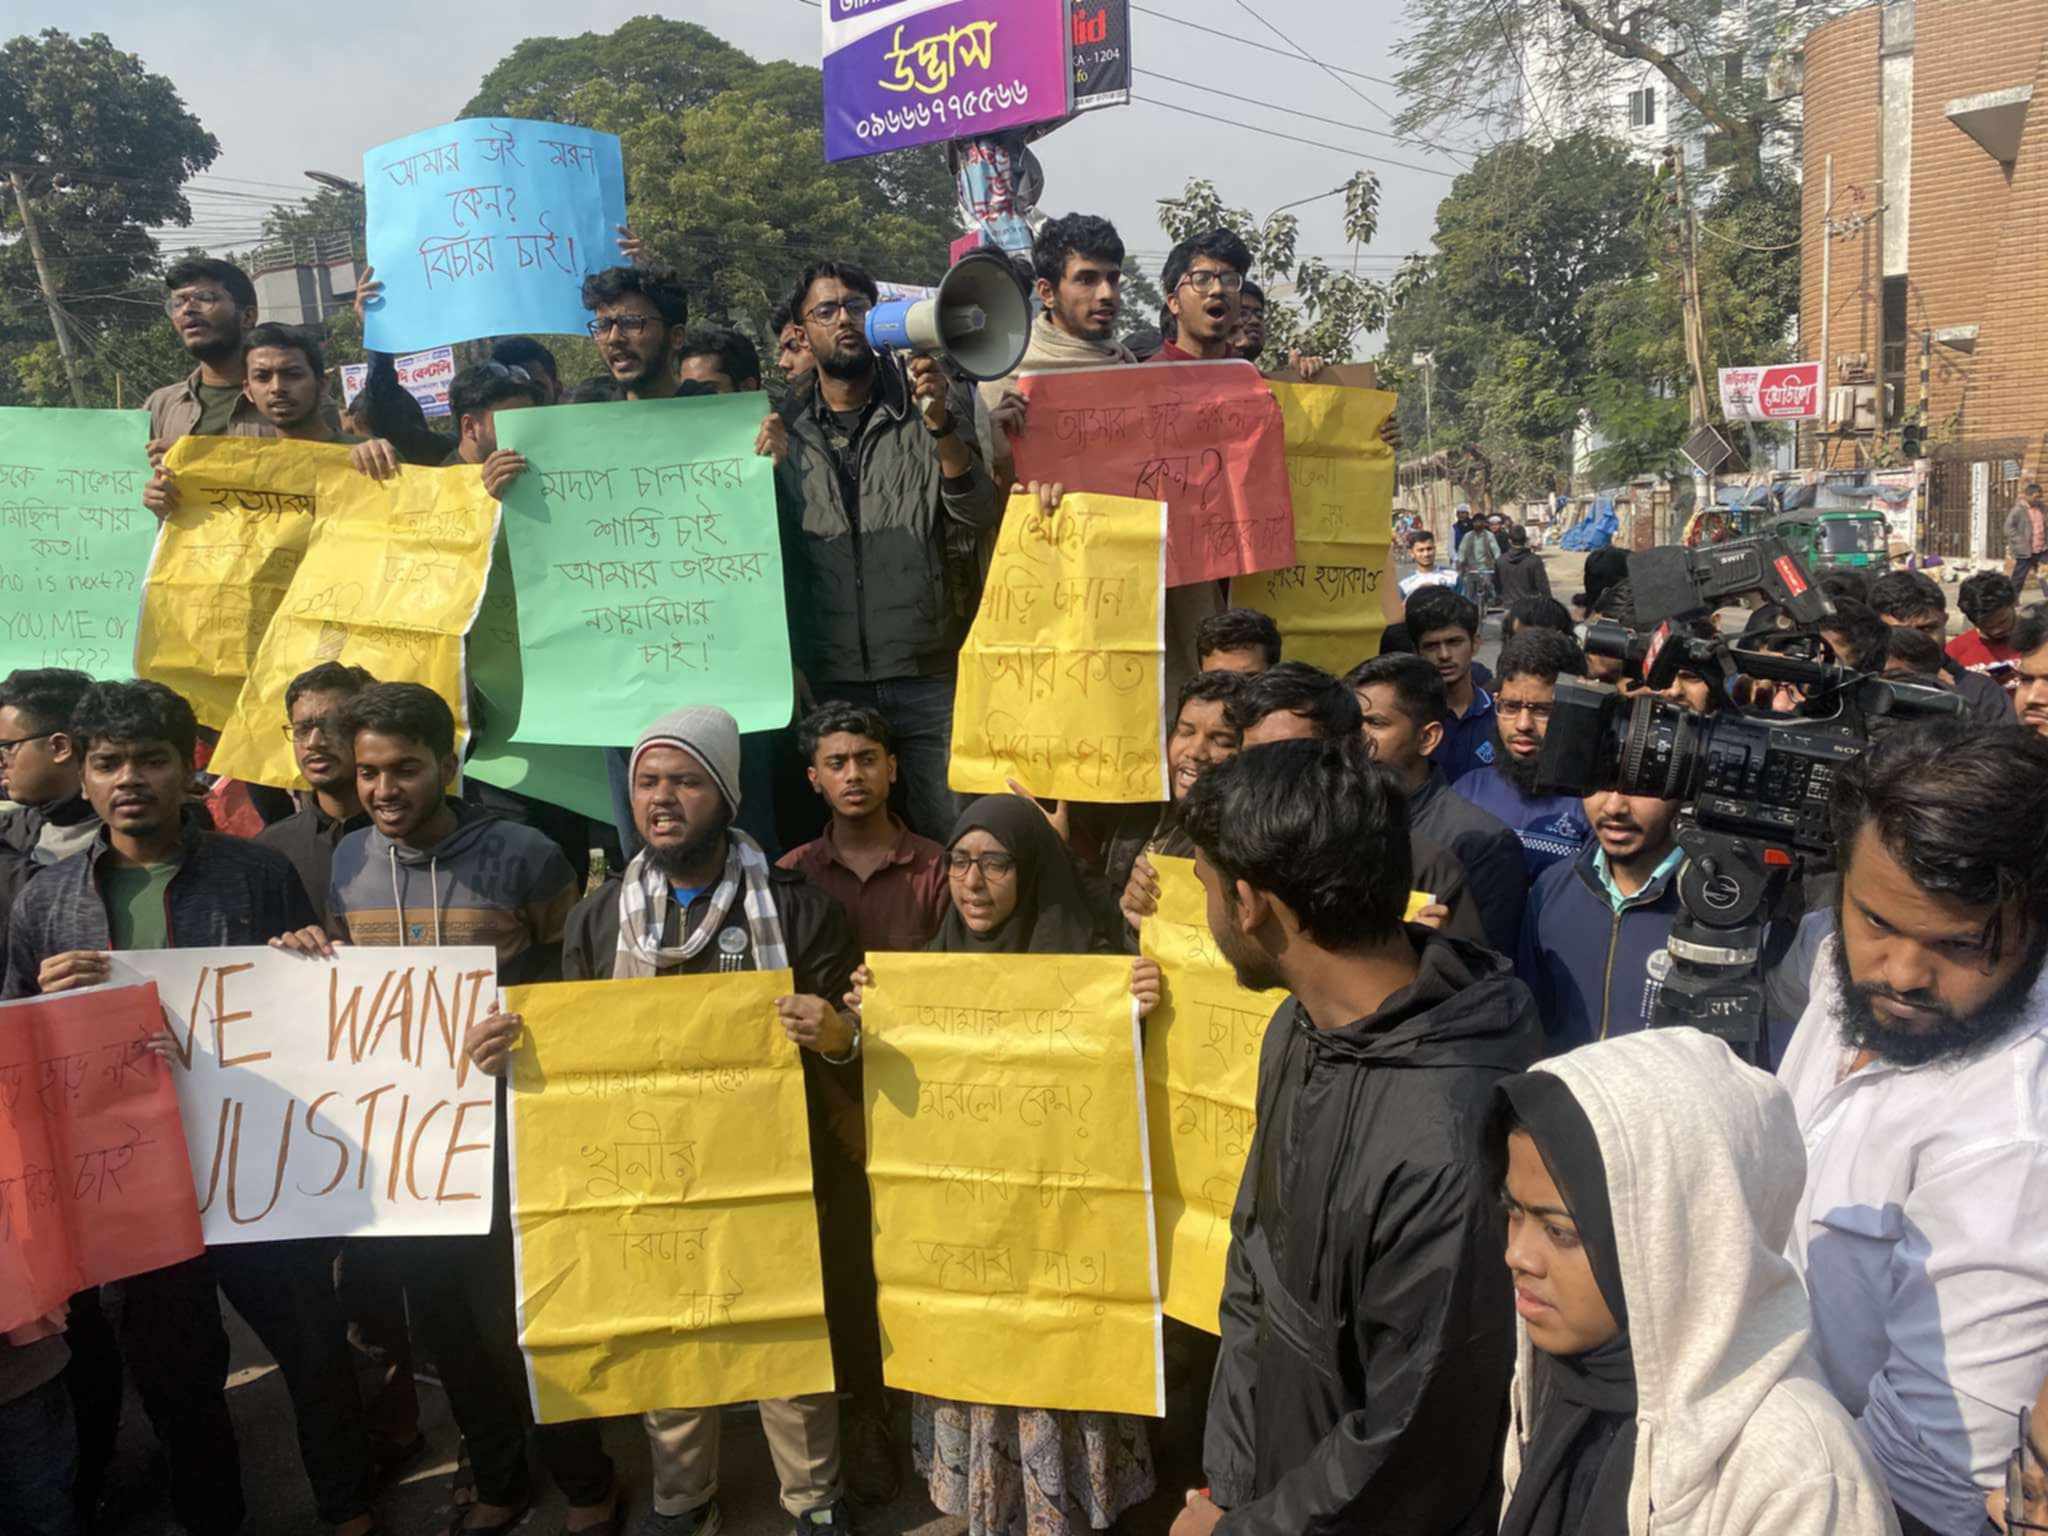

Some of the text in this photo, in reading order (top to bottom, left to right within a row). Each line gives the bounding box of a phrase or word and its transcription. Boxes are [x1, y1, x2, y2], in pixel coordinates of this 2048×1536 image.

[879, 20, 997, 94] উদ্ভাস
[1094, 48, 1120, 65] 1204
[856, 80, 1028, 138] ০৯৬৬৬৭৭৫৫৬৬
[382, 141, 460, 187] আমার
[446, 185, 518, 228] কেন?
[418, 230, 496, 290] বিচার
[630, 457, 745, 498] চালকের
[79, 508, 138, 533] আর
[586, 494, 727, 548] শাস্তি চাই
[30, 536, 90, 560] কত!!
[553, 544, 769, 591] আমার ভাইয়ের
[36, 566, 57, 593] is
[69, 570, 136, 593] next??
[980, 644, 1146, 703] আর কত
[327, 966, 495, 1090] WANT
[898, 1004, 1011, 1037] আমার
[564, 1064, 659, 1100] আমার
[920, 1079, 1094, 1139] মরলো কেন?
[73, 1121, 157, 1204] চাই
[200, 1083, 494, 1225] JUSTICE
[1028, 1159, 1096, 1216] চাই
